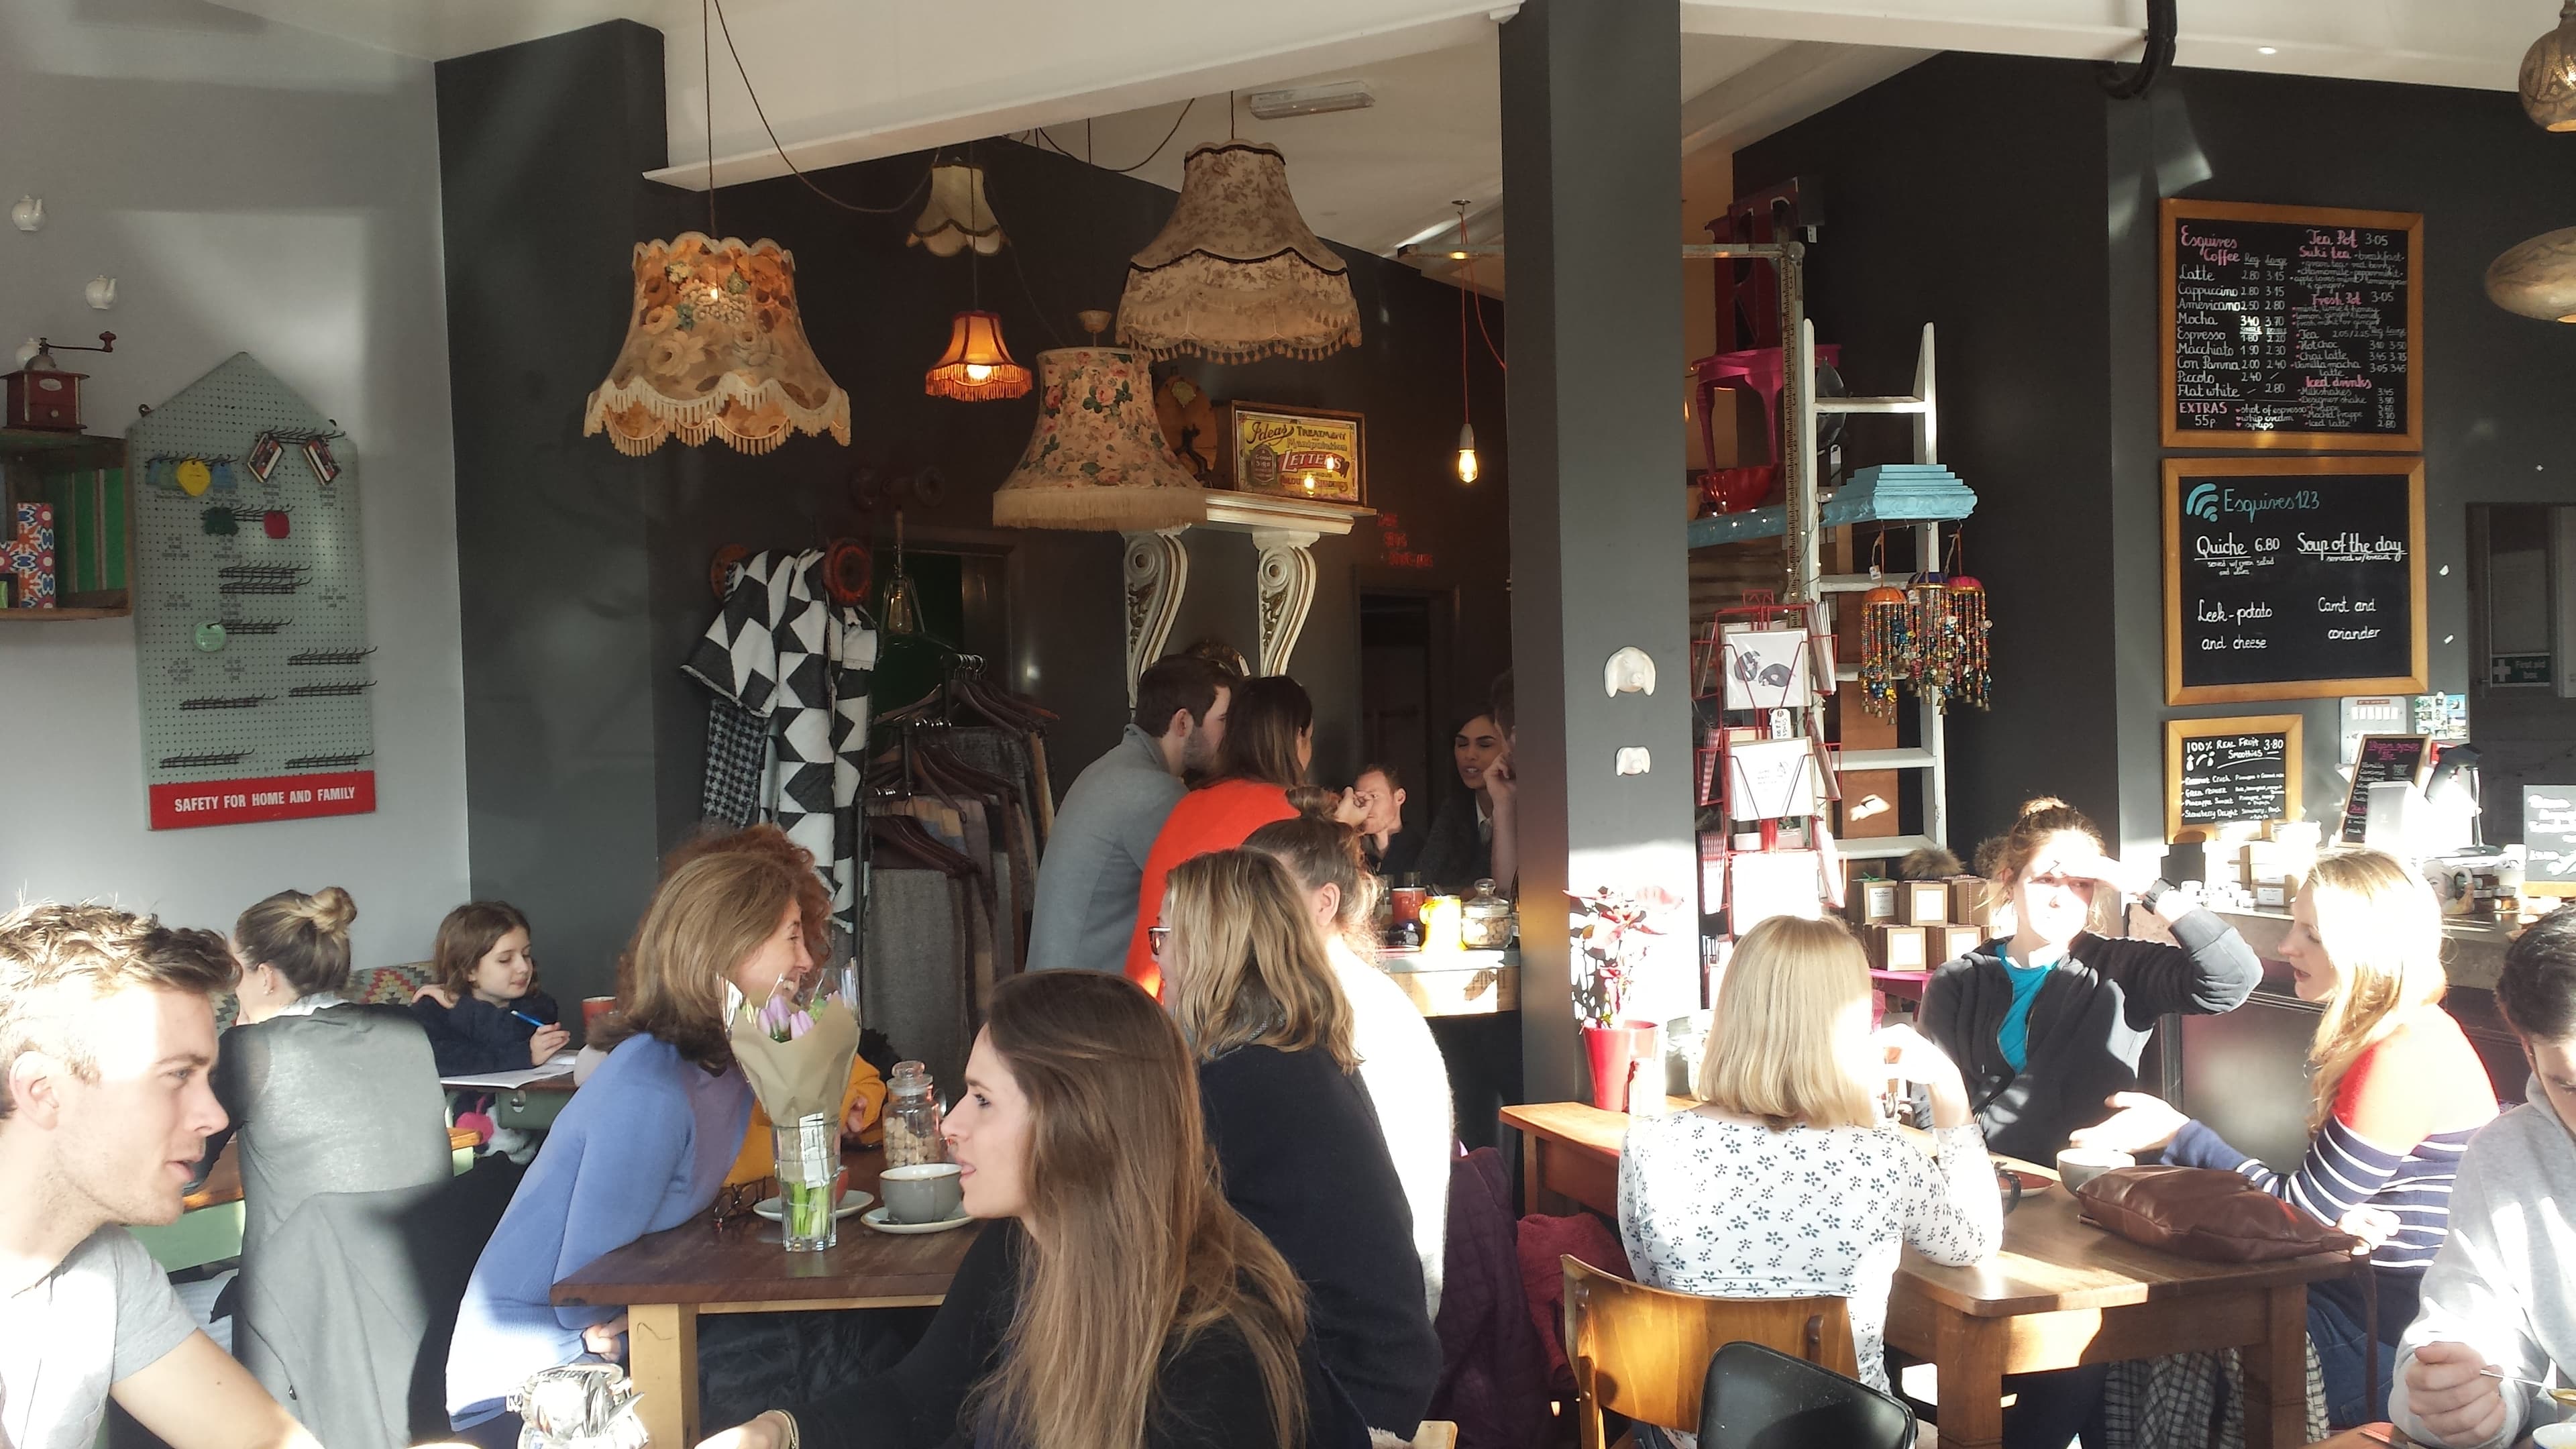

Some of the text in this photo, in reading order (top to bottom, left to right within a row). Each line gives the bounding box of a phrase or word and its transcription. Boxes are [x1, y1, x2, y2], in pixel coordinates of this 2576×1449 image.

[2181, 225, 2238, 256] Esquires
[2305, 229, 2333, 246] Tea
[2337, 229, 2358, 248] Pot
[2204, 248, 2241, 266] Coffee
[2244, 252, 2260, 268] Reg
[2299, 246, 2327, 258] Suki
[2331, 247, 2351, 259] tea
[2179, 264, 2215, 281] Latte
[2178, 282, 2239, 301] Cappuccino
[2311, 292, 2345, 305] Fresh
[2345, 292, 2361, 305] Pot
[2177, 298, 2241, 311] Americano
[2177, 311, 2218, 325] Mocha
[2177, 326, 2226, 345] Espresso
[2299, 329, 2320, 339] Tea
[2176, 341, 2234, 356] Macchiato
[2298, 340, 2318, 350] Hot
[2300, 352, 2322, 360] Chai
[2324, 349, 2348, 360] latte
[2178, 356, 2199, 368] Con
[2202, 356, 2241, 370] Panna
[2177, 370, 2214, 384] Piccolo
[2332, 374, 2372, 389] drinks
[2178, 384, 2204, 396] Flat
[2206, 383, 2240, 397] white
[2180, 402, 2227, 414] EXTRAS
[2241, 404, 2261, 413] shot
[2262, 405, 2271, 415] of
[2194, 414, 2216, 428] 55p
[1246, 421, 1295, 445] Ideas
[2196, 532, 2280, 558] Quiche 6.80
[2297, 532, 2406, 561] Soup of the day
[2355, 598, 2376, 612] and
[2328, 626, 2381, 640] coriander
[2202, 634, 2267, 650] and cheese
[2186, 741, 2213, 753] 100%
[175, 787, 355, 812] SAFETY FOR HOME AND FAMILY
